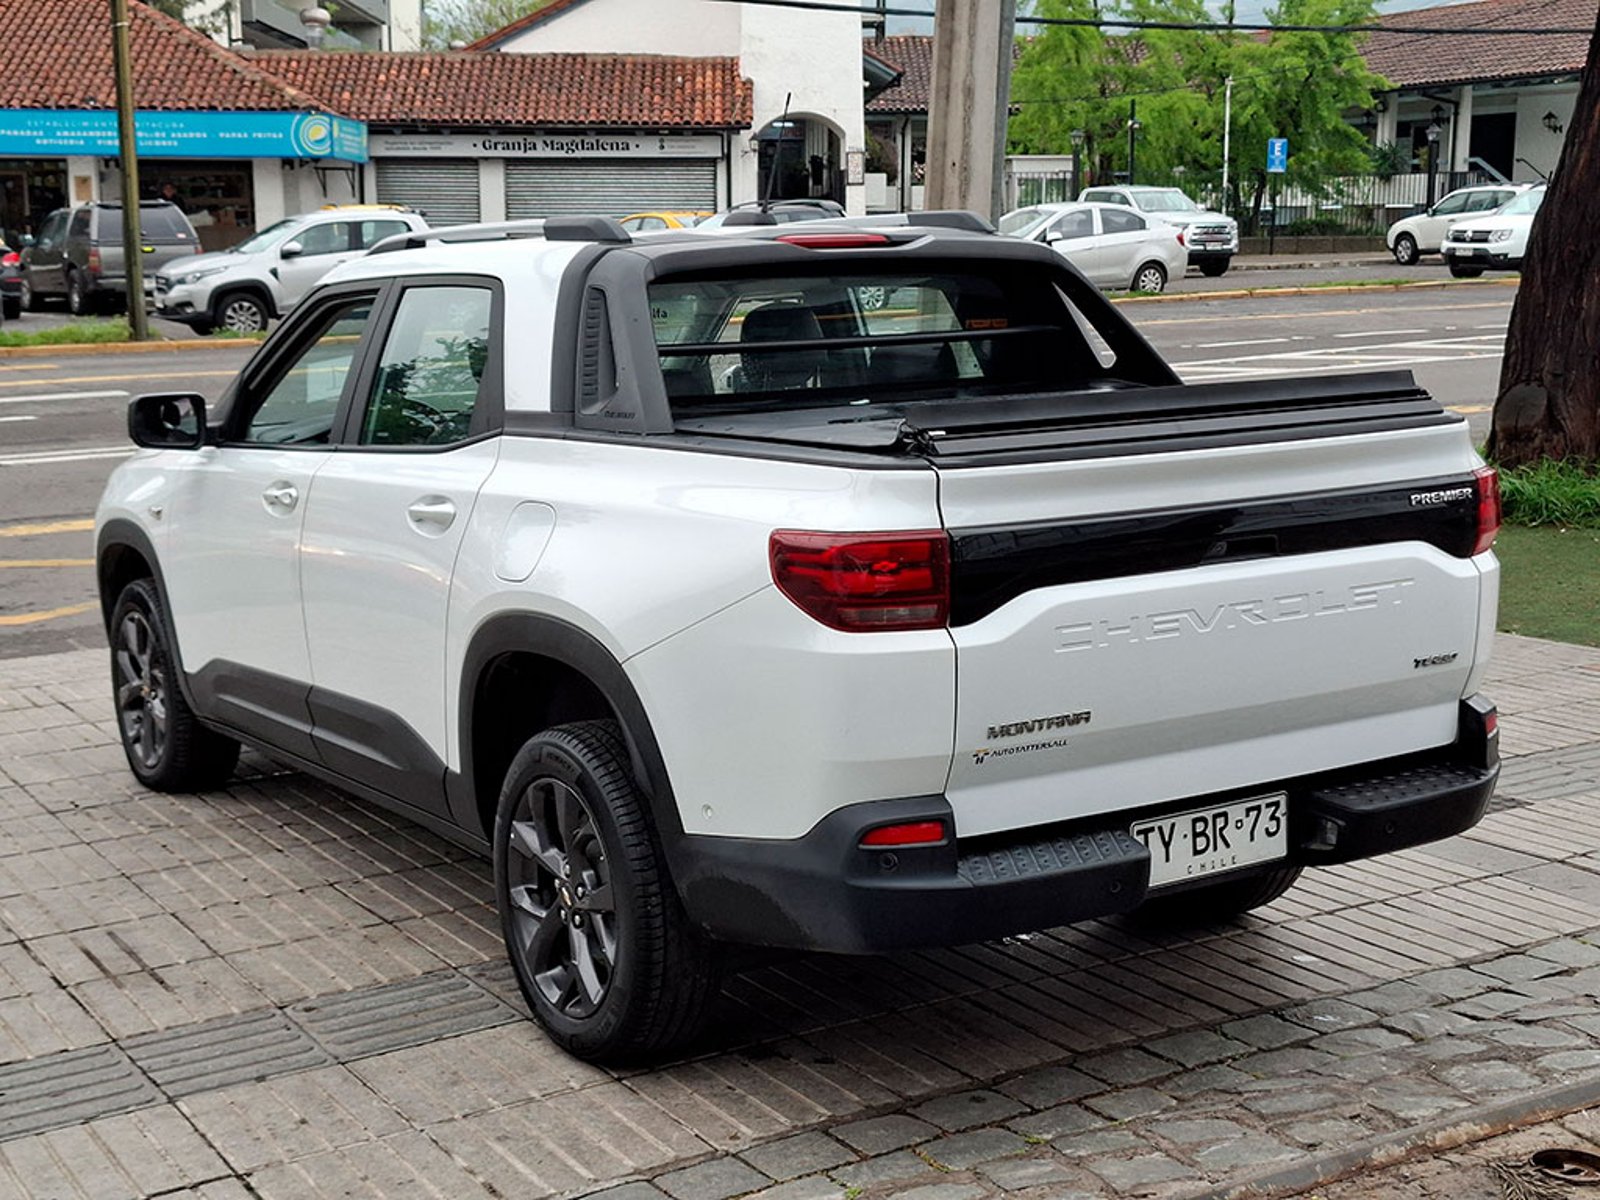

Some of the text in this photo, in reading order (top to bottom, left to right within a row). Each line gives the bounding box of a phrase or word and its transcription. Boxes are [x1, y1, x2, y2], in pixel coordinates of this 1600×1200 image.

[482, 138, 631, 154] Granja Magdalena
[1274, 143, 1282, 156] E
[1410, 487, 1473, 506] PREMIER
[1054, 577, 1415, 653] CHEVROLET
[987, 711, 1092, 740] MONTANA
[1186, 855, 1238, 875] CHILE
